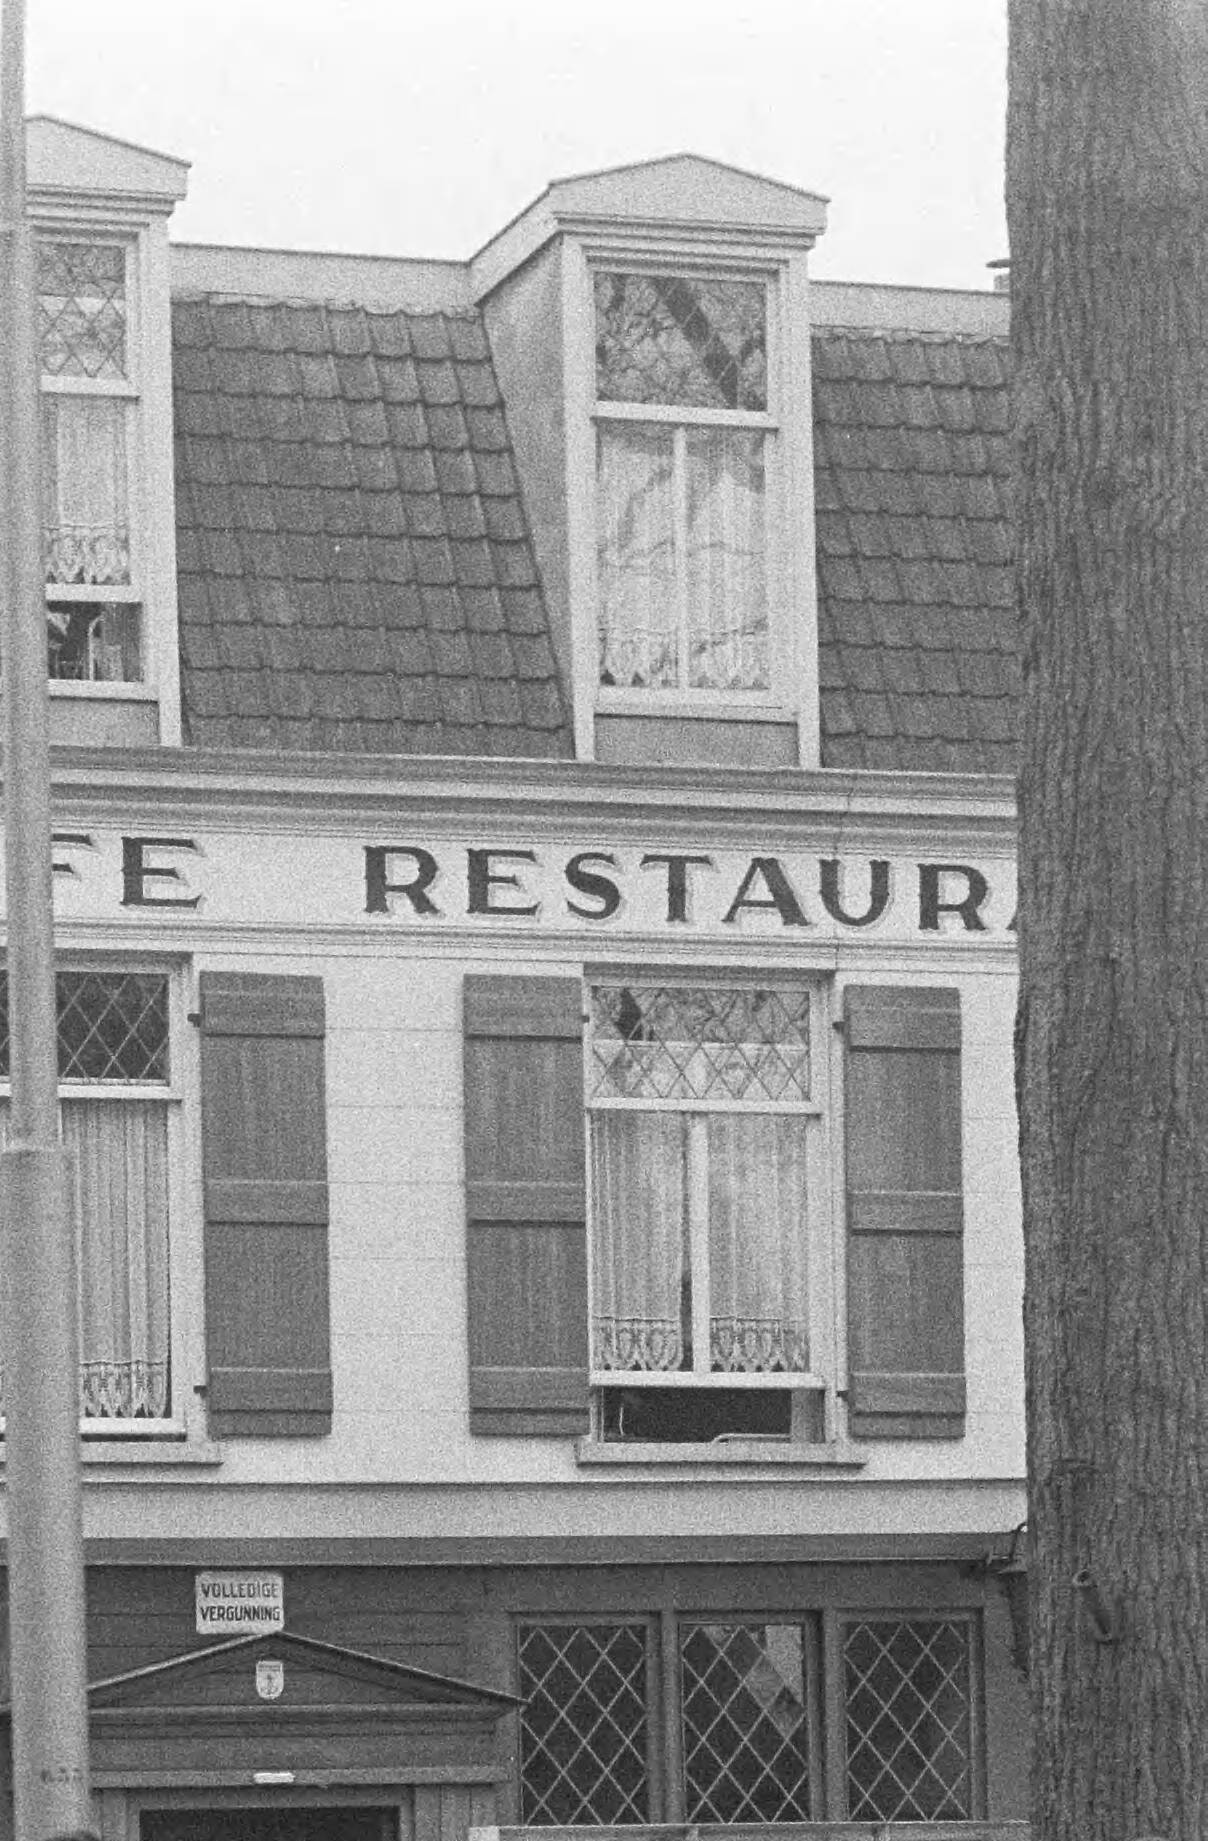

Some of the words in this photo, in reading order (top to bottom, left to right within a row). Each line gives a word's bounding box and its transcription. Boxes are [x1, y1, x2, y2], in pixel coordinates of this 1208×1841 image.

[363, 845, 1018, 930] RESTAUR
[201, 1583, 280, 1598] VOLLEDIGE
[200, 1605, 281, 1621] VERGUNNING
